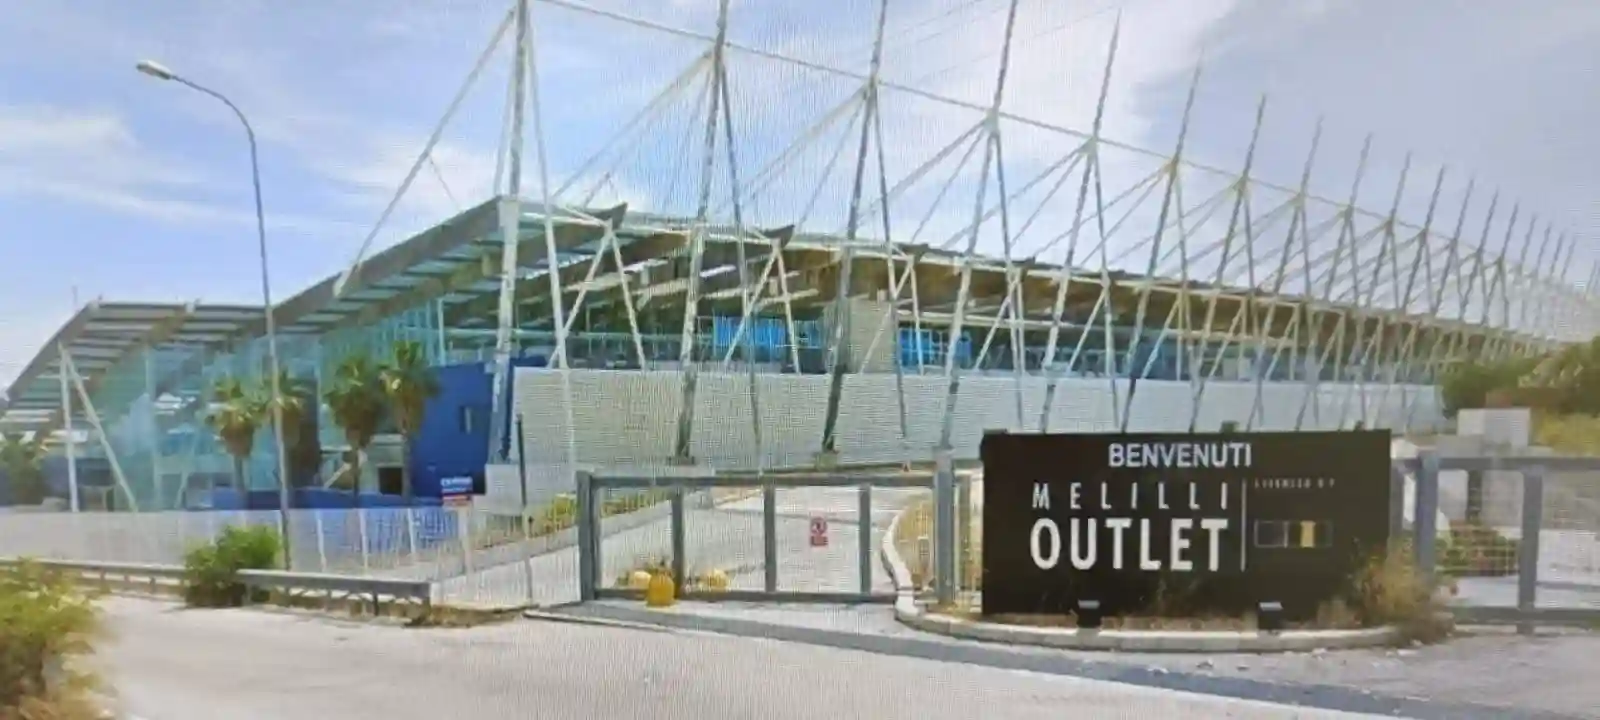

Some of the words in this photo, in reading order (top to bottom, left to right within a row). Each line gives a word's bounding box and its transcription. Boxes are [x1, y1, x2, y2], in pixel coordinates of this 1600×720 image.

[1108, 442, 1251, 468] BENVENUTI
[1032, 482, 1228, 509] MELILLI
[1030, 518, 1228, 571] OUTLET
